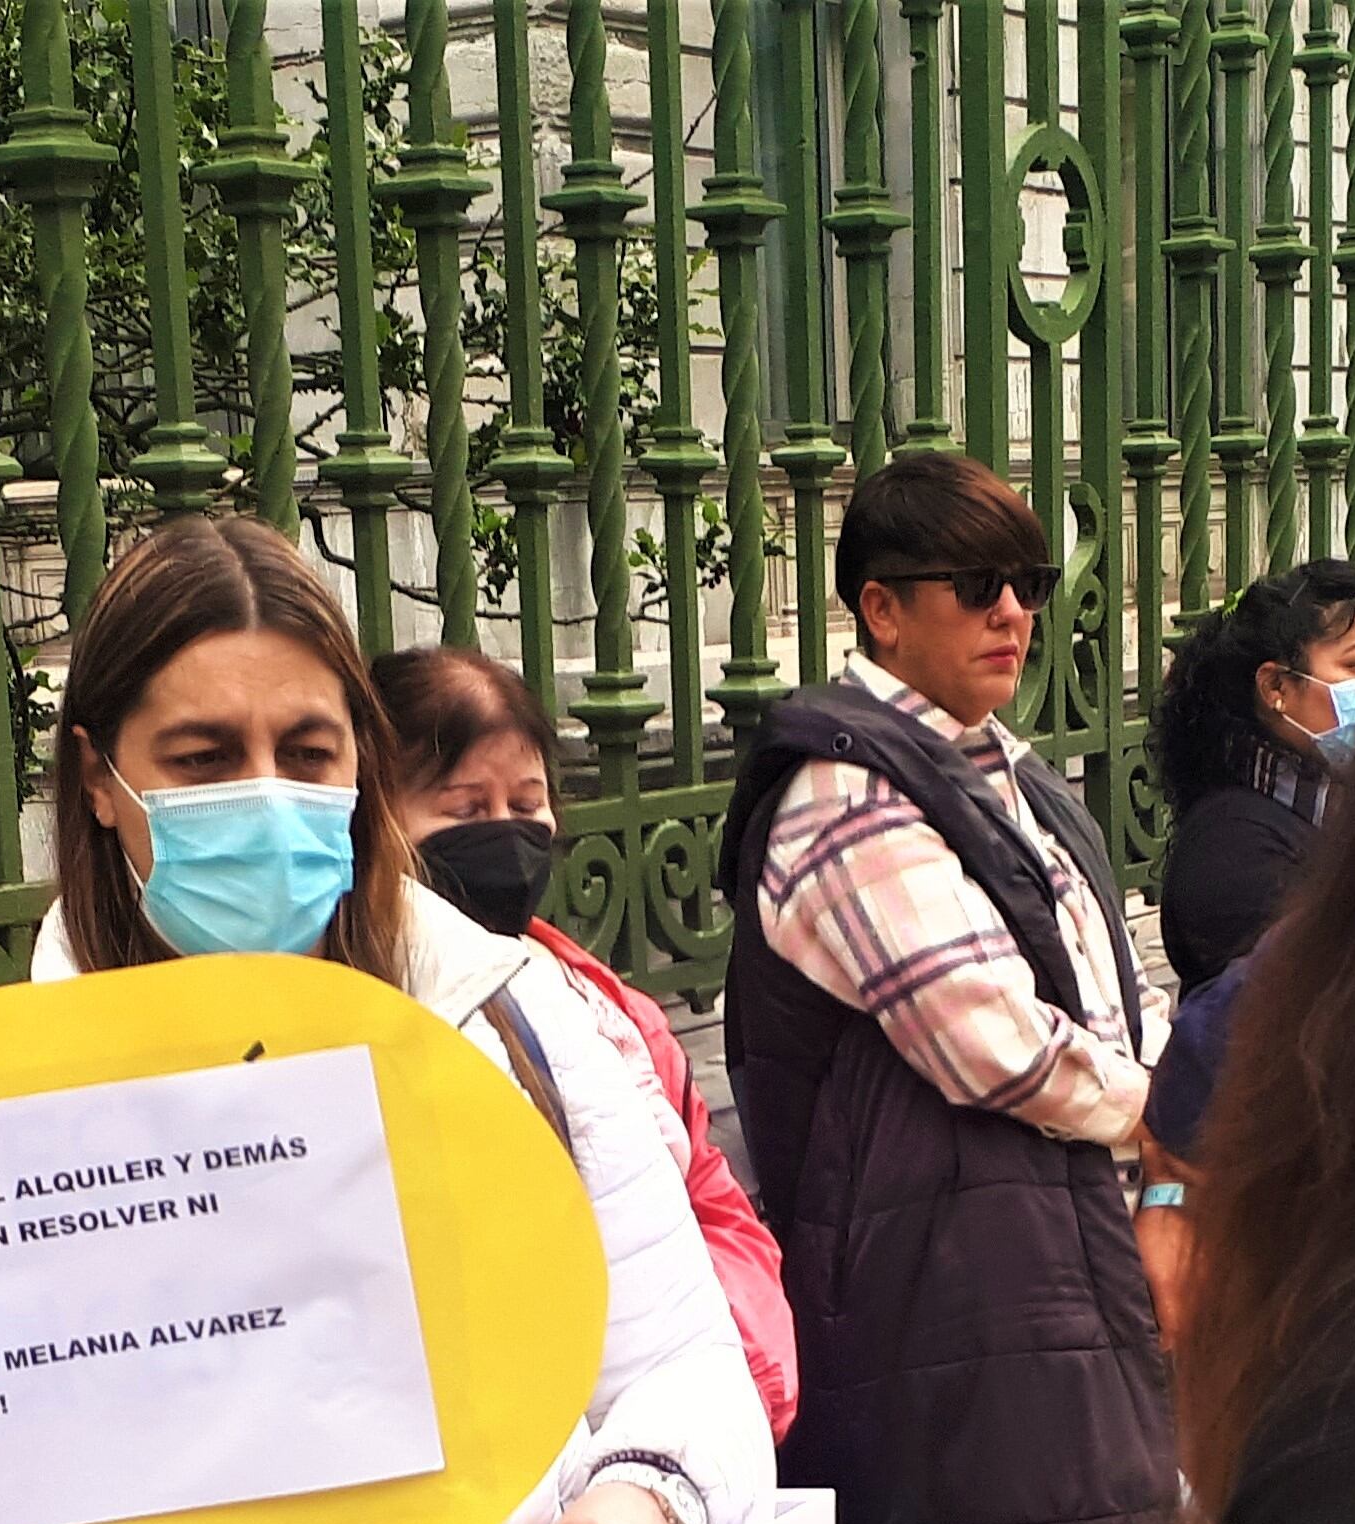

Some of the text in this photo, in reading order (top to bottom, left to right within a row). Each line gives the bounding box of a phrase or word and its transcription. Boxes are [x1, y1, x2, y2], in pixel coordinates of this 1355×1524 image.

[15, 1157, 167, 1200] ALQUILER
[173, 1152, 192, 1174] Y
[202, 1134, 308, 1171] DEMÁS
[18, 1199, 180, 1243] RESOLVER
[186, 1192, 219, 1217] NI
[3, 1330, 141, 1371] MELANIA
[149, 1306, 287, 1348] ALVAREZ
